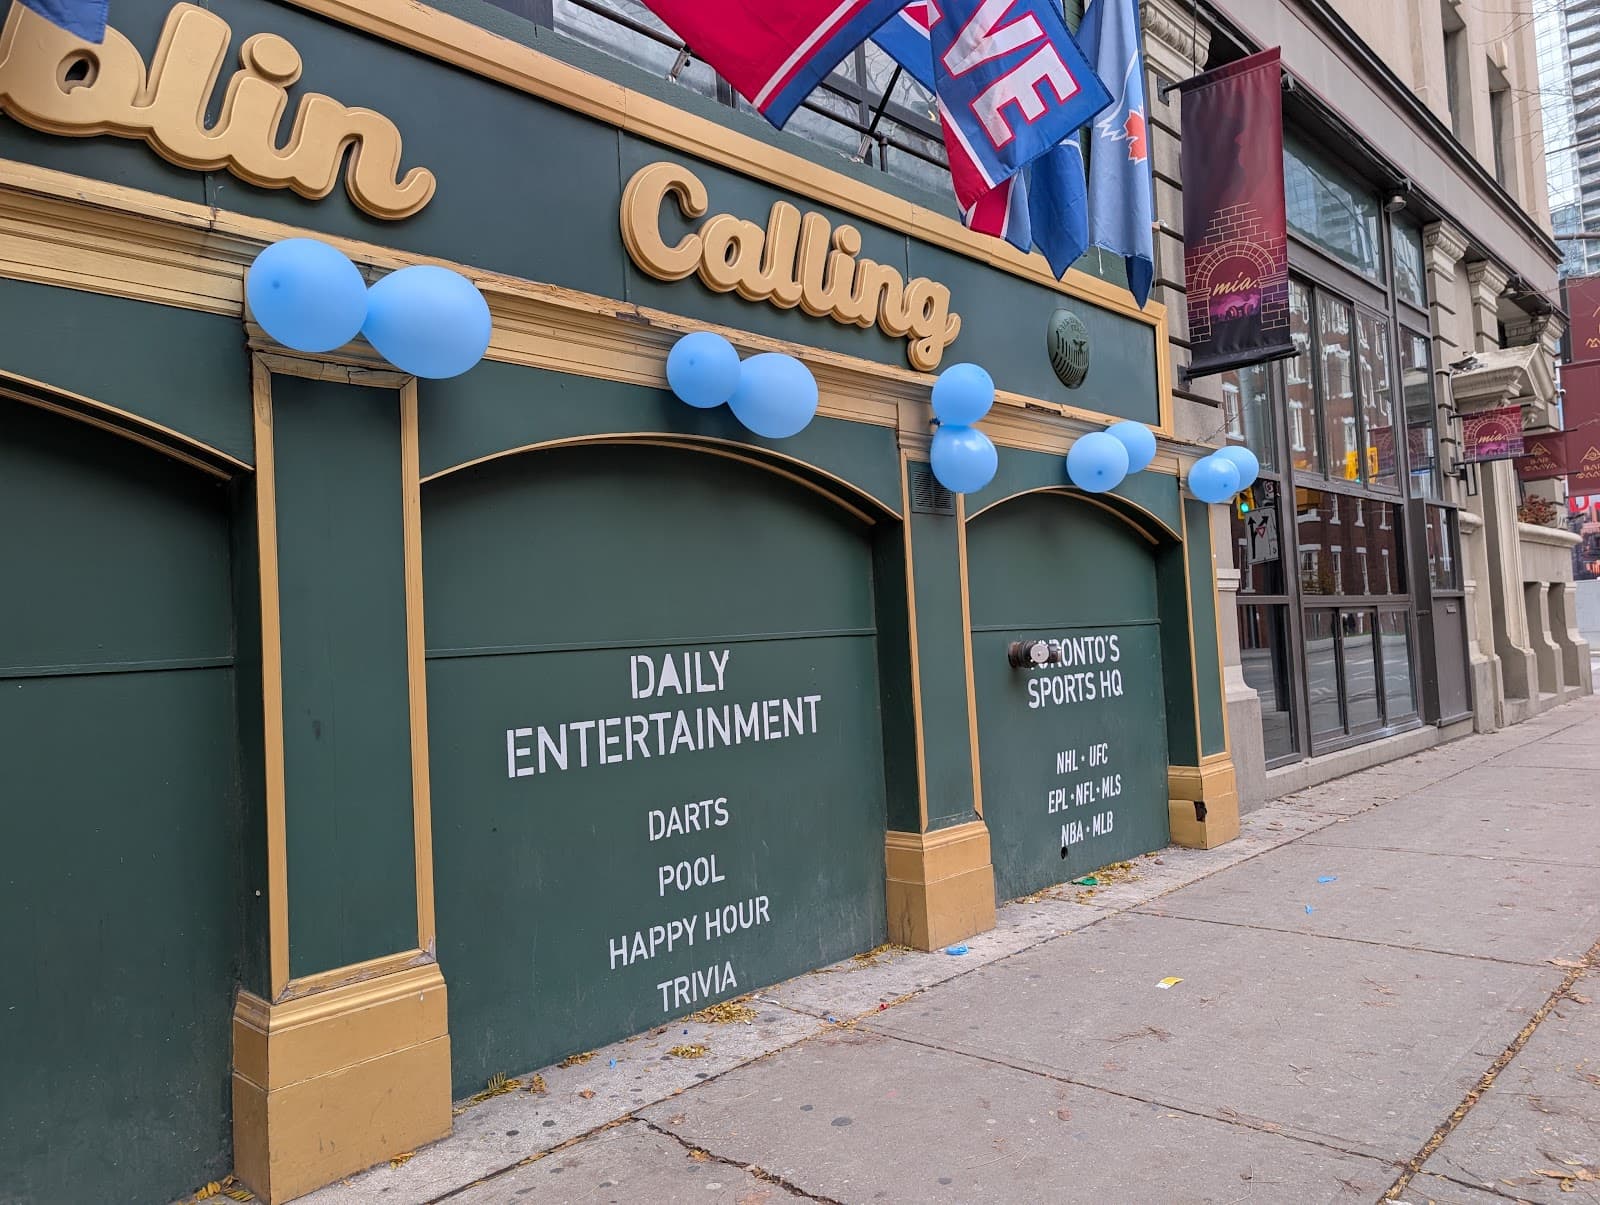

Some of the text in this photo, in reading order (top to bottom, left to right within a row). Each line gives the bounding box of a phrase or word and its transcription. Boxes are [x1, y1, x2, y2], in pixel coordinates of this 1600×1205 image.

[620, 161, 961, 371] Calling
[1030, 634, 1120, 670] RONTO'S
[630, 649, 730, 699] DAILY
[1027, 668, 1124, 709] SPORTS HQ
[506, 694, 822, 779] ENTERTAINMENT
[1056, 742, 1109, 775] NHL UFC
[1047, 773, 1122, 814] EPL NFL MLS
[648, 797, 729, 841] DARTS
[1061, 810, 1114, 848] NBA MLB
[658, 854, 726, 897] POOL
[609, 895, 771, 970] HAPPY HOUR
[656, 960, 738, 1012] TRIVIA
